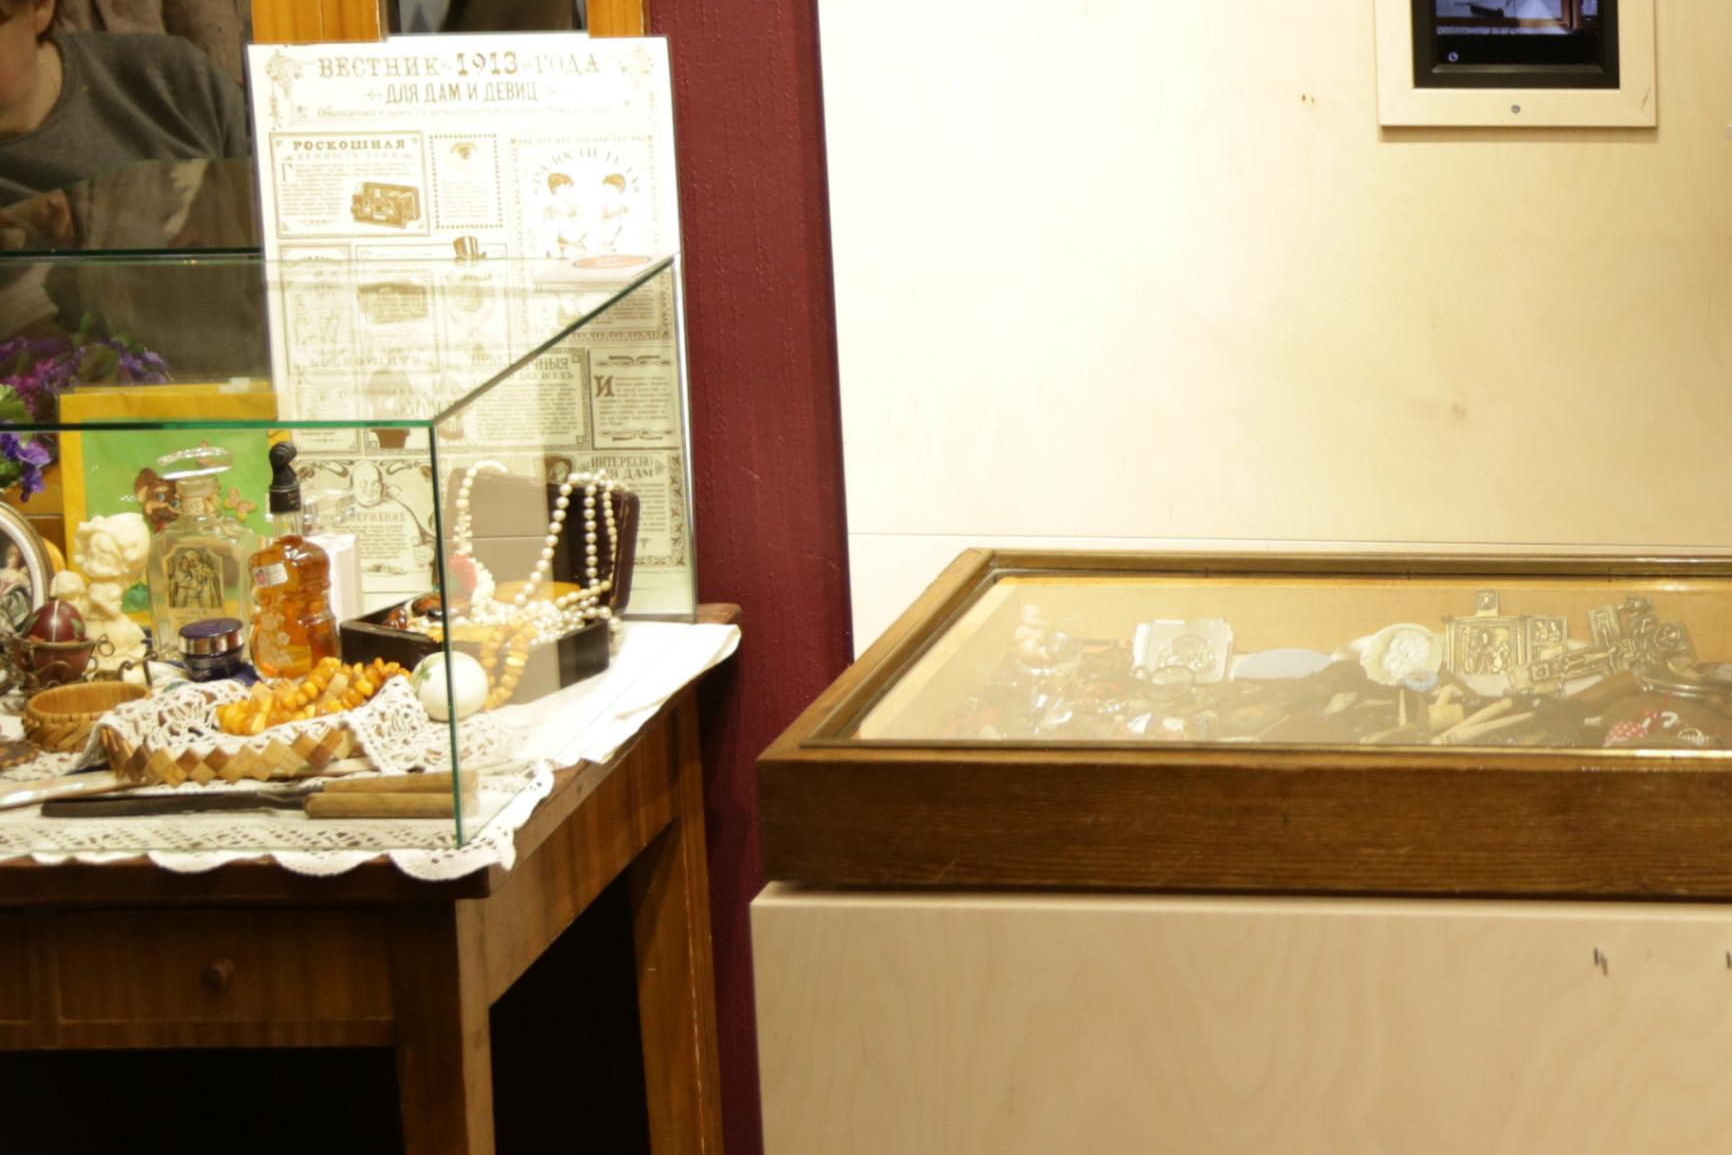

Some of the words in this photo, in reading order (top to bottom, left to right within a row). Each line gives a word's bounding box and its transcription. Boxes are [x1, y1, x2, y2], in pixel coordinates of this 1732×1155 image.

[317, 55, 440, 78] ВЕСТНИК
[455, 51, 519, 76] 1913
[533, 53, 600, 76] ГОДА
[385, 83, 418, 105] ДЛЯ
[423, 82, 461, 104] ДАМ
[466, 82, 478, 101] И
[483, 81, 538, 102] ДЕВИЦ
[293, 140, 406, 151] РОСКОШНАЯ
[623, 468, 654, 480] ДАМ
